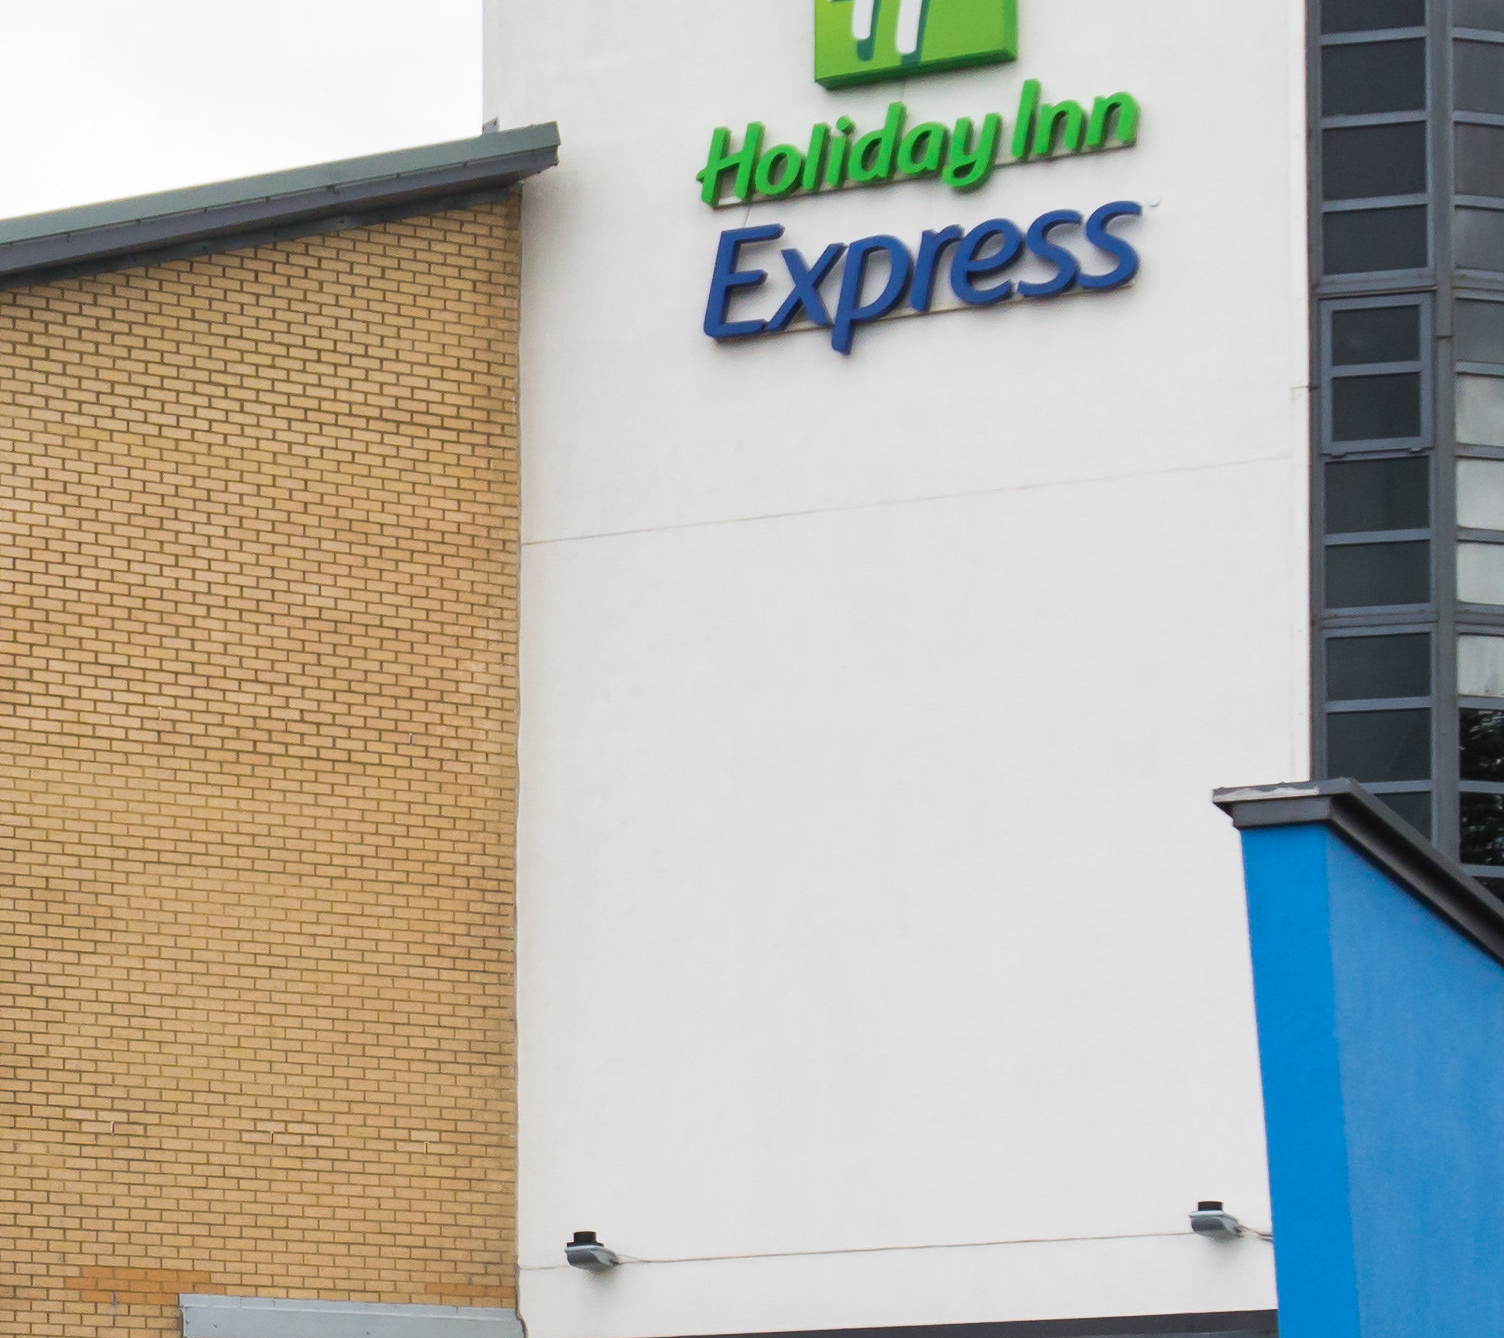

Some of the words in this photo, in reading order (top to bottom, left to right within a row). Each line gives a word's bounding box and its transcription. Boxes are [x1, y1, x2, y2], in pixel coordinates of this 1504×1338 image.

[696, 101, 1002, 207] Holiday
[1011, 78, 1142, 160] Inn
[703, 200, 1143, 355] Express
